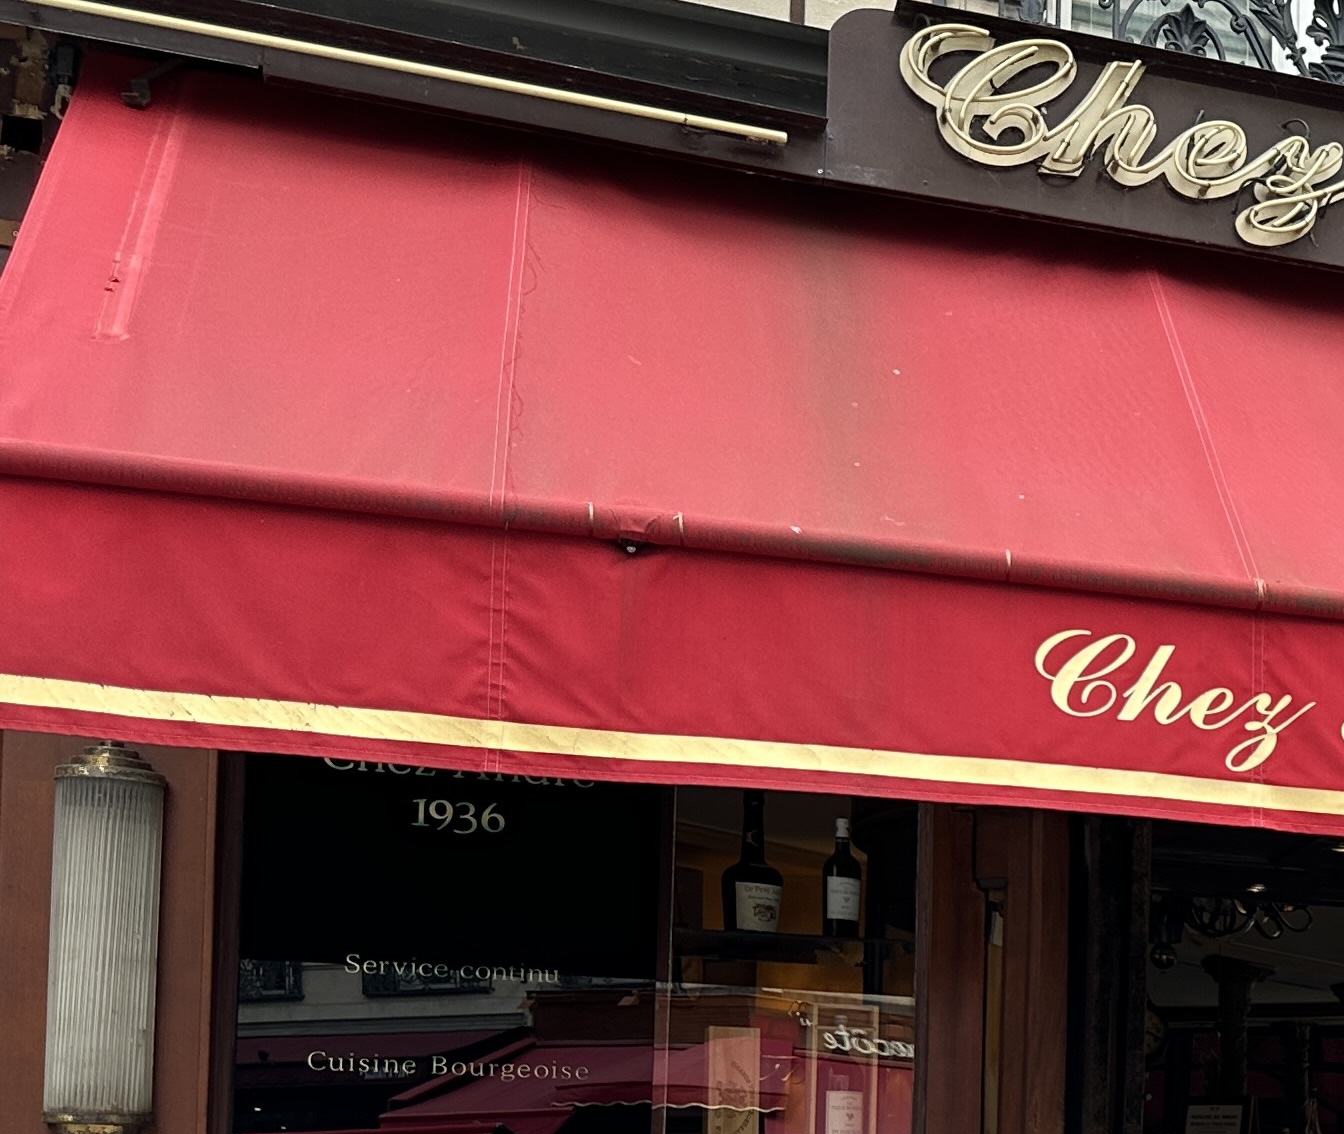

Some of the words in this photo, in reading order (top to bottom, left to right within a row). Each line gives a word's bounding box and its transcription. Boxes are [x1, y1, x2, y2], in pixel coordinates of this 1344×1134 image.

[1034, 629, 1317, 772] Chez
[411, 799, 506, 834] 1936
[344, 953, 449, 979] Service
[459, 962, 560, 984] continu
[306, 1050, 417, 1075] Cuisine
[430, 1055, 590, 1082] Bourgeoise
